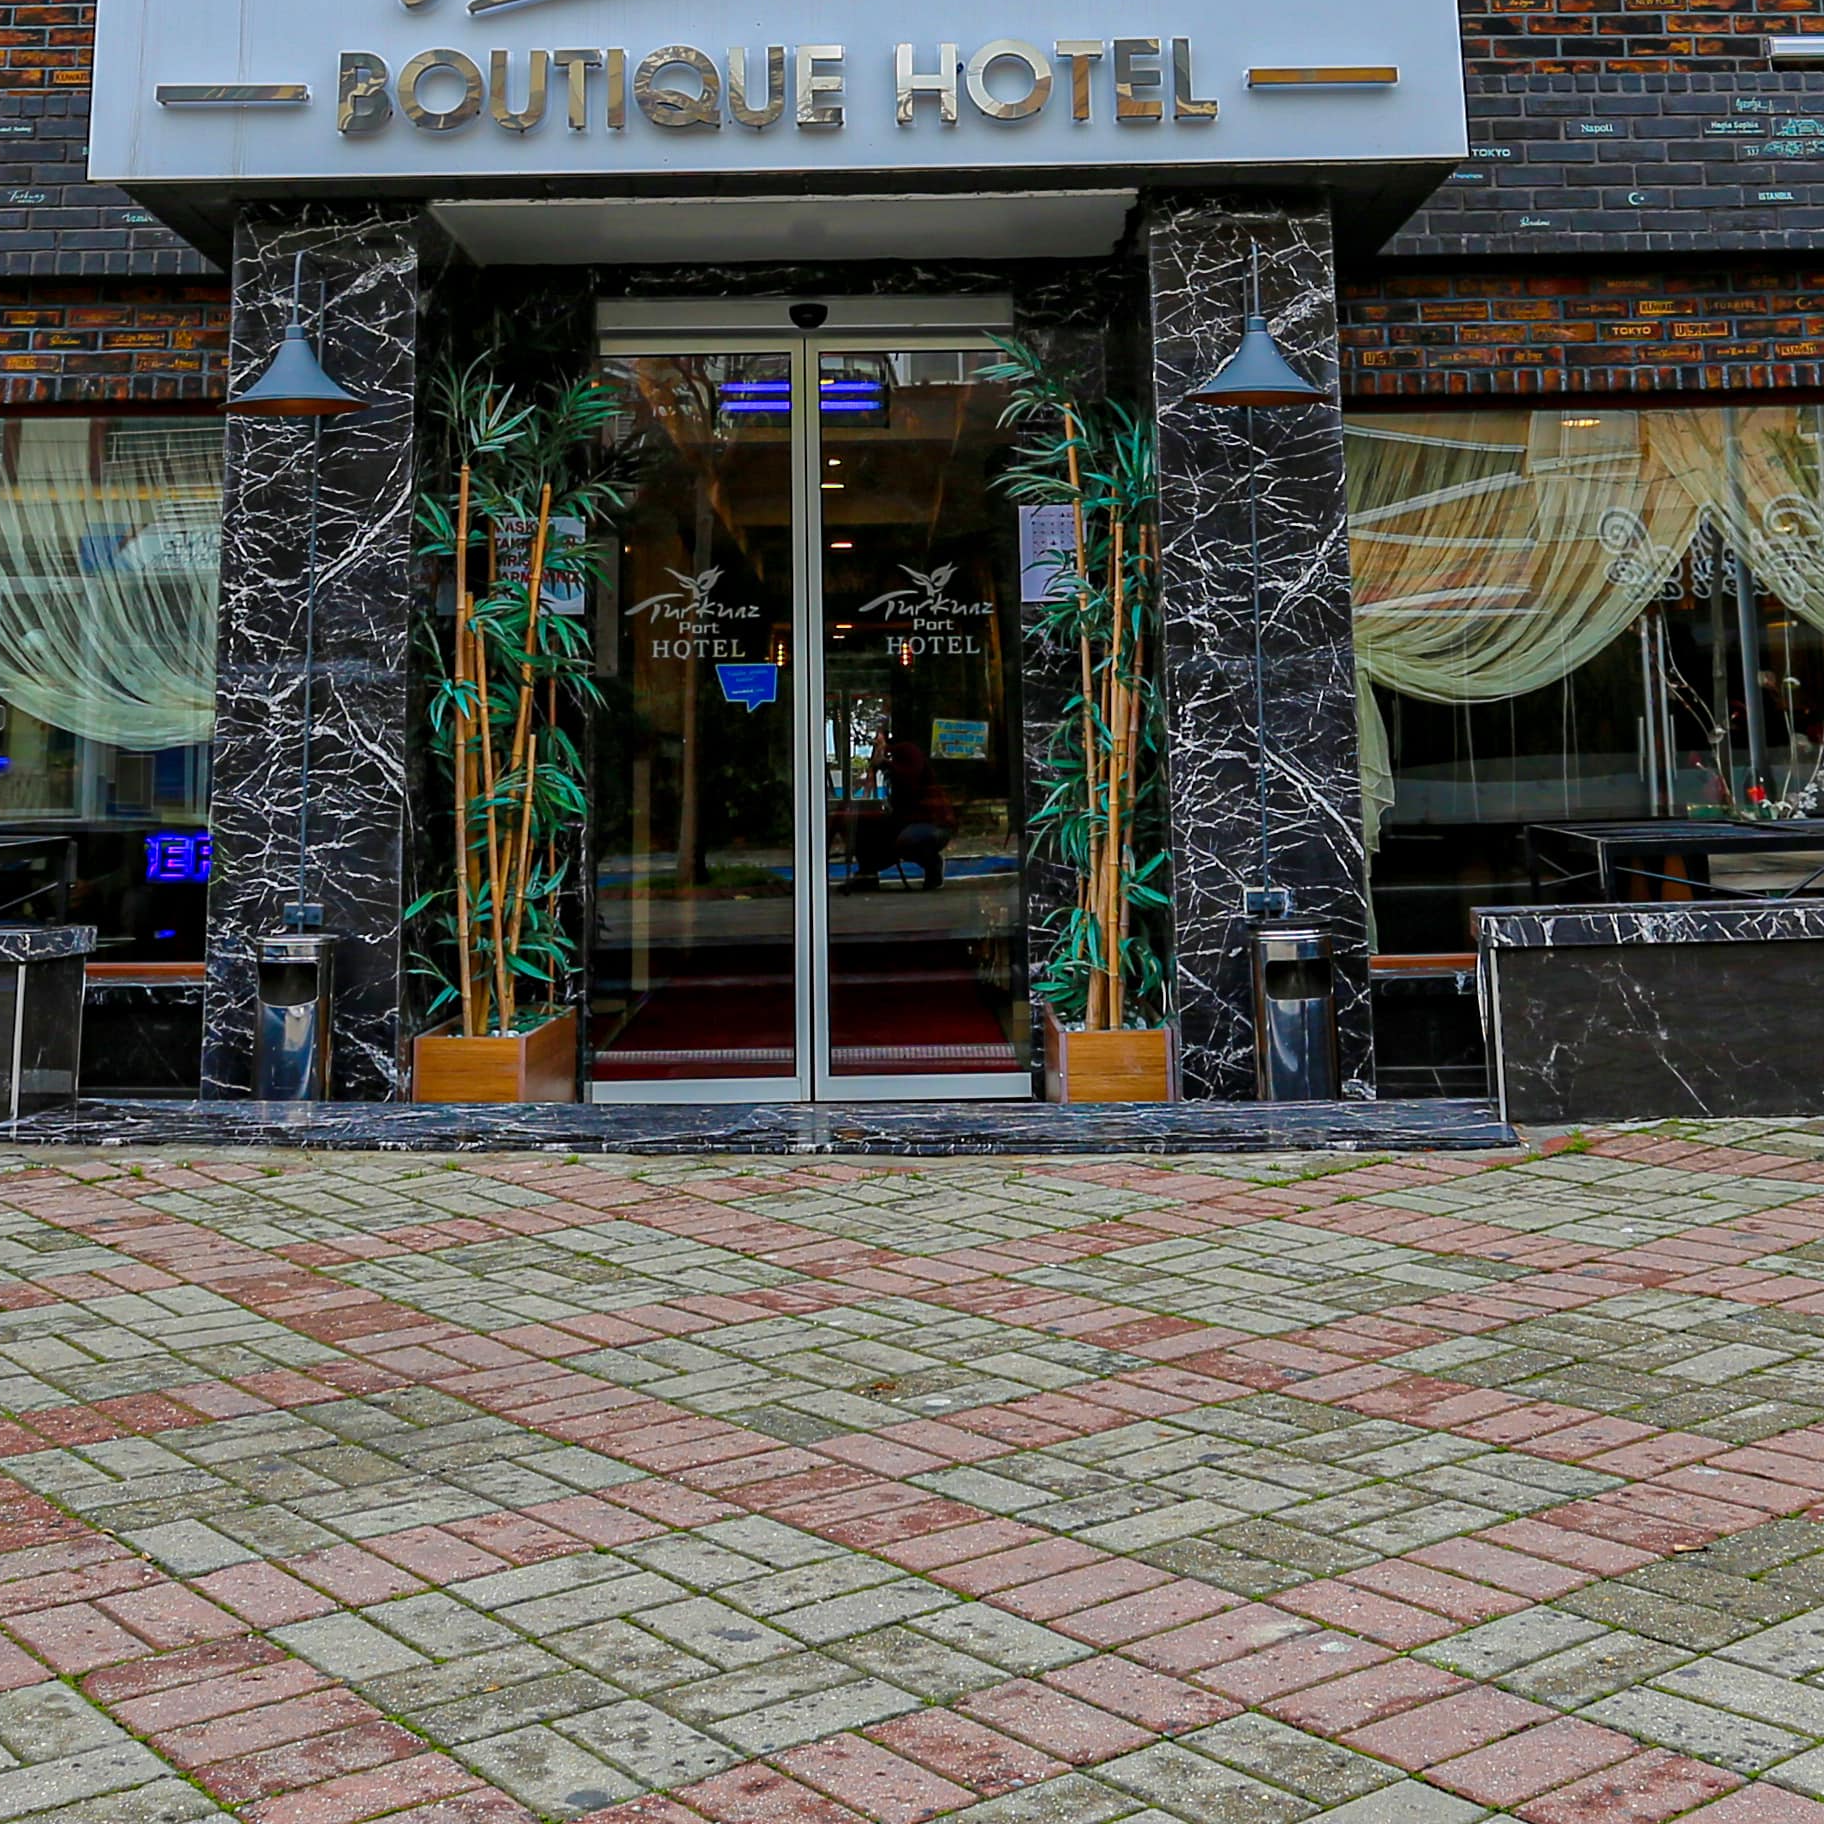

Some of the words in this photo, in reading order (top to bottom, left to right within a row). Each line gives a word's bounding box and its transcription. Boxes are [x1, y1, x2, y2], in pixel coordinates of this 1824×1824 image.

[336, 44, 846, 133] BOUTIQUE
[894, 37, 1220, 125] HOTEL
[1580, 123, 1613, 134] Napoli
[1471, 148, 1511, 157] TOKYO
[1612, 325, 1651, 336] TOKYO
[679, 621, 720, 634] Port
[913, 618, 955, 631] Port
[651, 639, 746, 659] HOTEL
[886, 635, 981, 655] HOTEL
